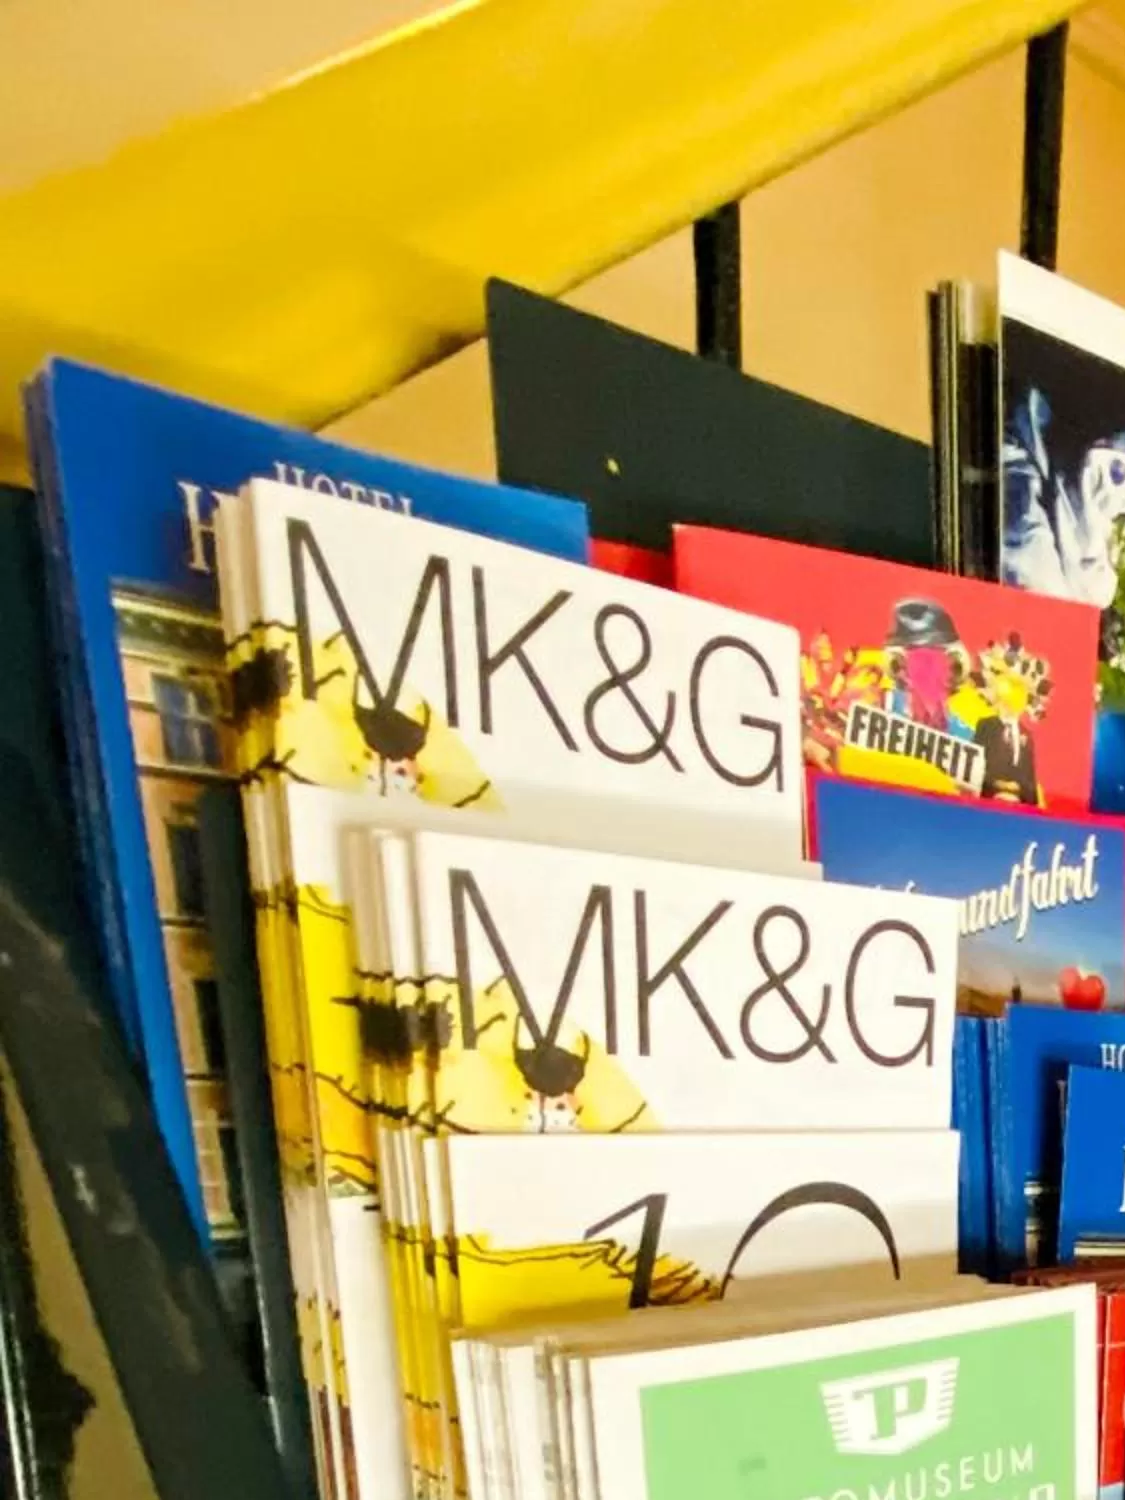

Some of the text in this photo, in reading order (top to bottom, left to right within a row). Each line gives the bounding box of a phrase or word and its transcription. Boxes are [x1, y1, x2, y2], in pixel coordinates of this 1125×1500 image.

[286, 516, 785, 793] MK&G
[850, 705, 980, 783] FREIHEIT
[448, 868, 937, 1068] MK&G
